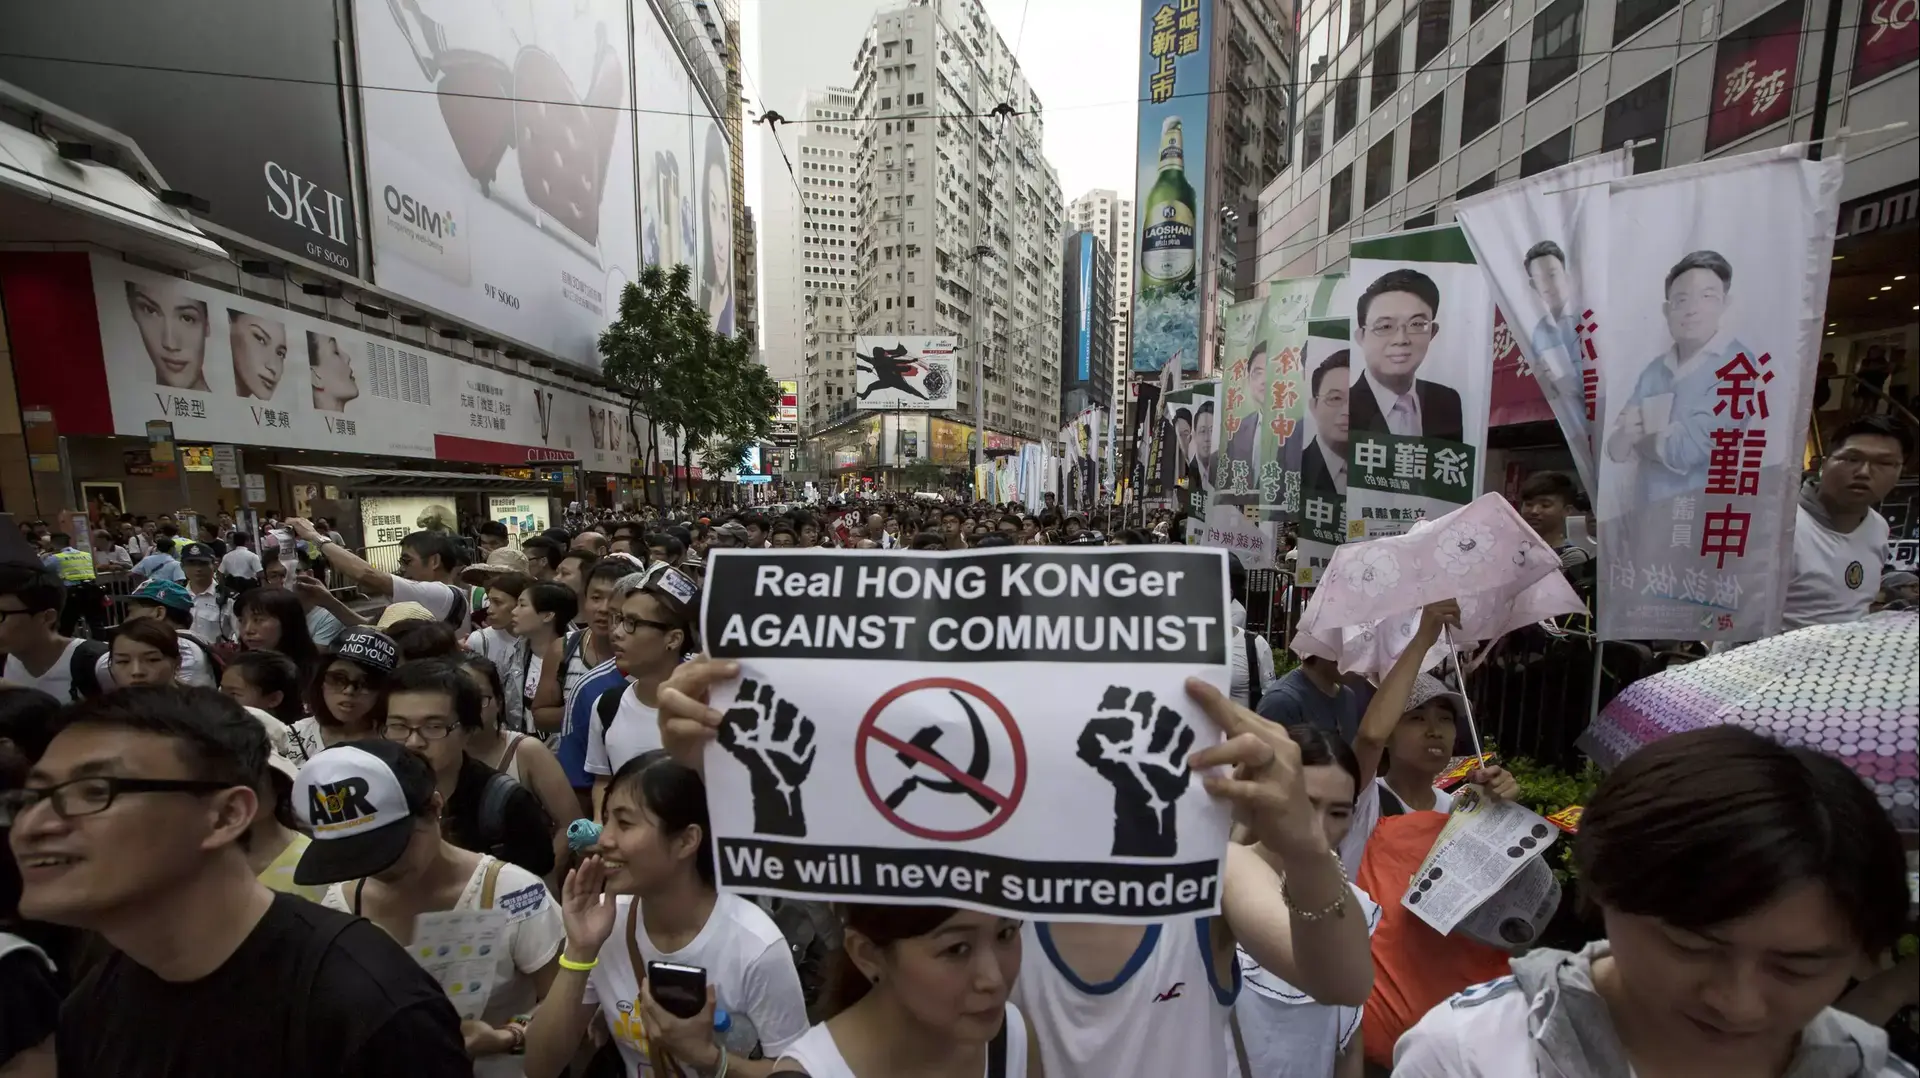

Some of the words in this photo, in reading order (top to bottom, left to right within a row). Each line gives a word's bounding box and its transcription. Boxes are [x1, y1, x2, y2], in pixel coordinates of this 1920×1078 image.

[1151, 4, 1177, 103] 全新上市
[1723, 60, 1787, 116] 莎莎
[264, 161, 348, 246] SK-II
[384, 184, 442, 239] OSIM
[1145, 225, 1192, 239] LAOSHAN
[306, 242, 321, 257] G/F
[324, 249, 349, 269] SOGO
[484, 282, 496, 299] 9/F
[498, 289, 520, 310] SOGO
[755, 564, 843, 597] Real
[857, 565, 986, 600] HONG
[1001, 563, 1185, 598] KONGer
[346, 633, 375, 645] JUST
[374, 638, 395, 656] WILD
[720, 613, 916, 649] AGAINST
[928, 615, 1216, 652] COMMUNIST
[340, 644, 364, 654] AND
[365, 647, 394, 668] YOUNG
[308, 776, 379, 826] AIR
[724, 846, 785, 879] We
[794, 853, 862, 886] will
[876, 861, 990, 895] never
[1001, 870, 1218, 908] surrender
